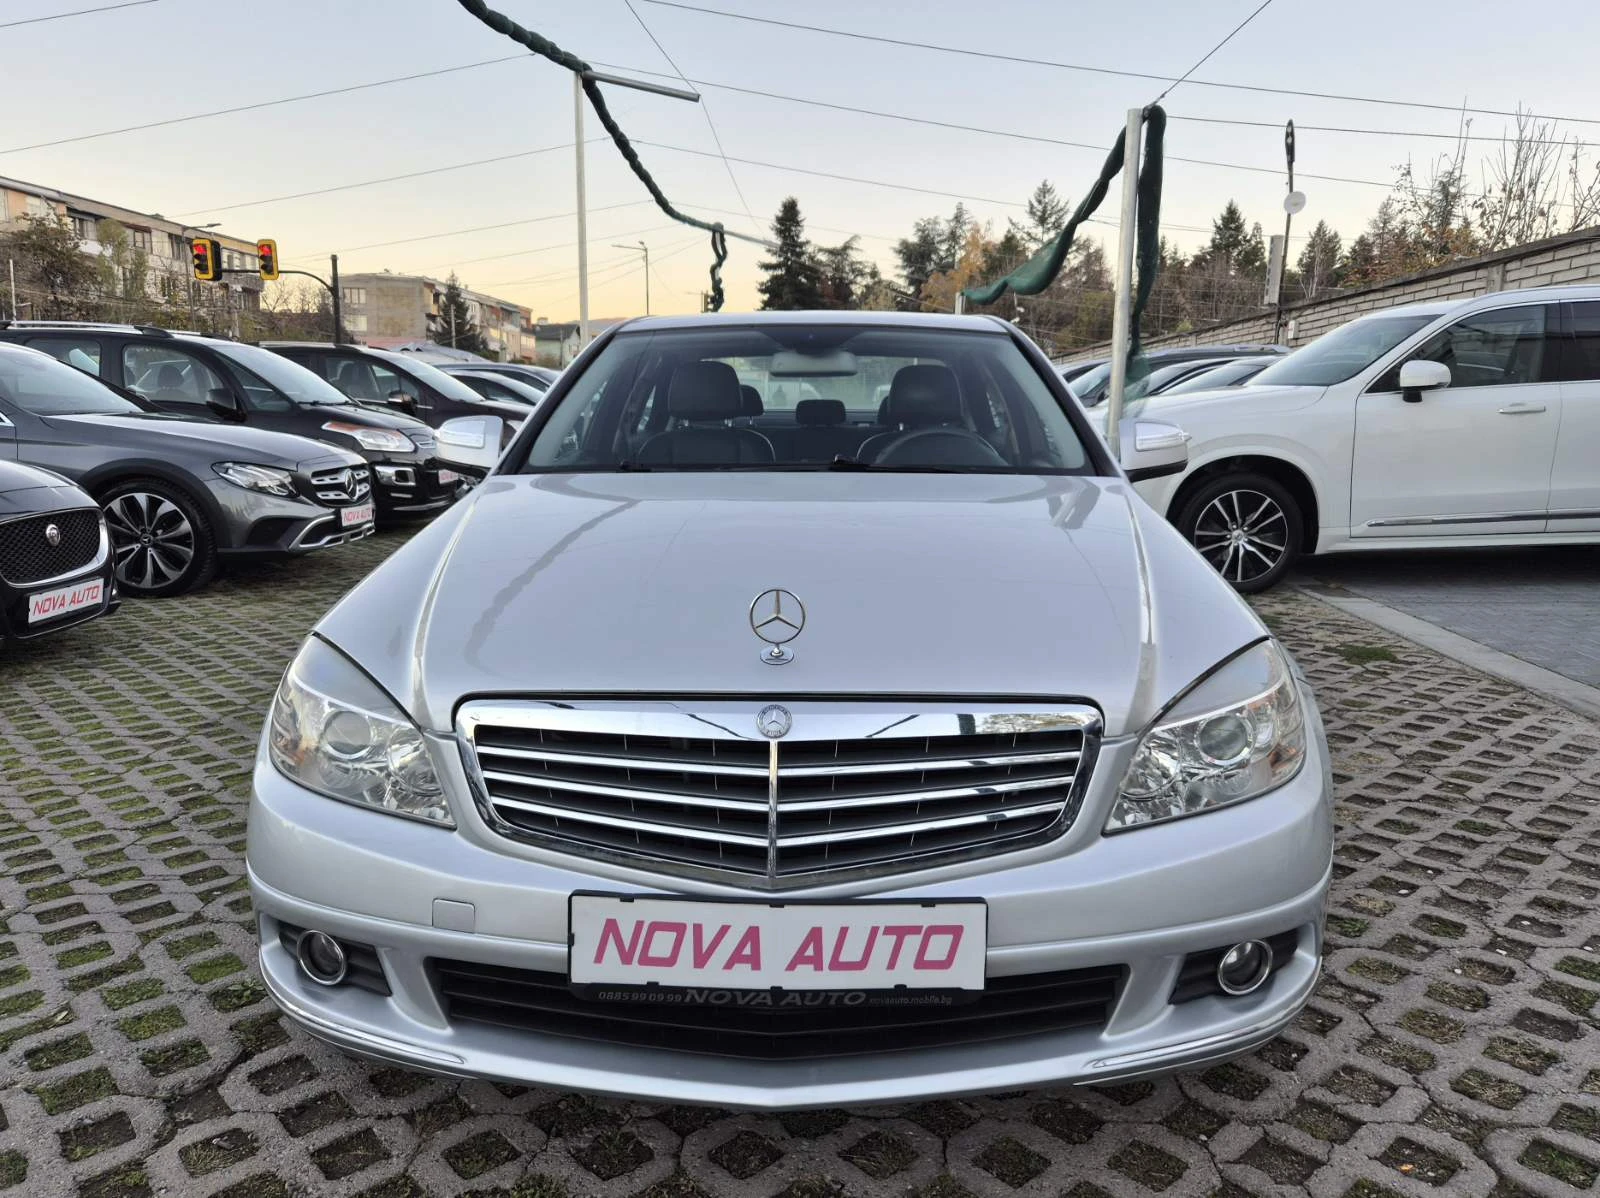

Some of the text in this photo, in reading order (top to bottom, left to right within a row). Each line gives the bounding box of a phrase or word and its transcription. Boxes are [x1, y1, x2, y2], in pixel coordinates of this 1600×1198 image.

[33, 585, 101, 616] NOVA AUTO
[593, 918, 965, 972] NOVA AUTO
[684, 988, 773, 1005] NOVA
[779, 990, 867, 1006] AUTO
